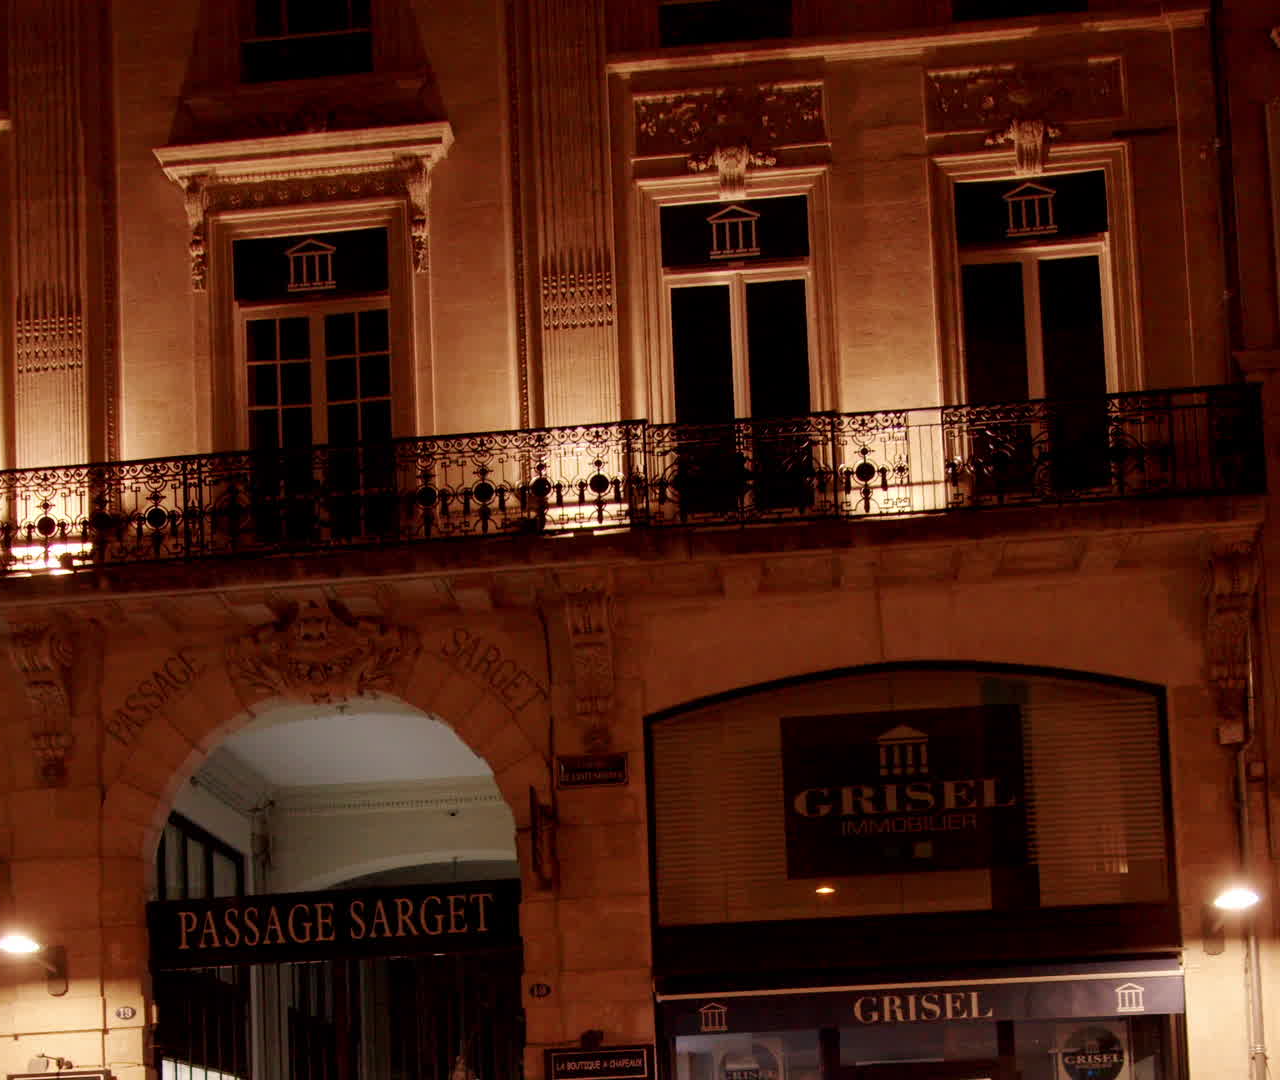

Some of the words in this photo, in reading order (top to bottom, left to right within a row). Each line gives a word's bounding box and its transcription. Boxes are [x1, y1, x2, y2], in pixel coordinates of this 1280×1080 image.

[441, 629, 551, 712] SARGET
[103, 645, 206, 746] PASSAGE
[793, 777, 1017, 818] GRISEL
[840, 813, 978, 838] IMMOBILIER
[175, 902, 338, 950] PASSAGE
[350, 892, 497, 941] SARGET
[853, 991, 993, 1024] GRISEL
[1064, 1053, 1124, 1065] GRISEL
